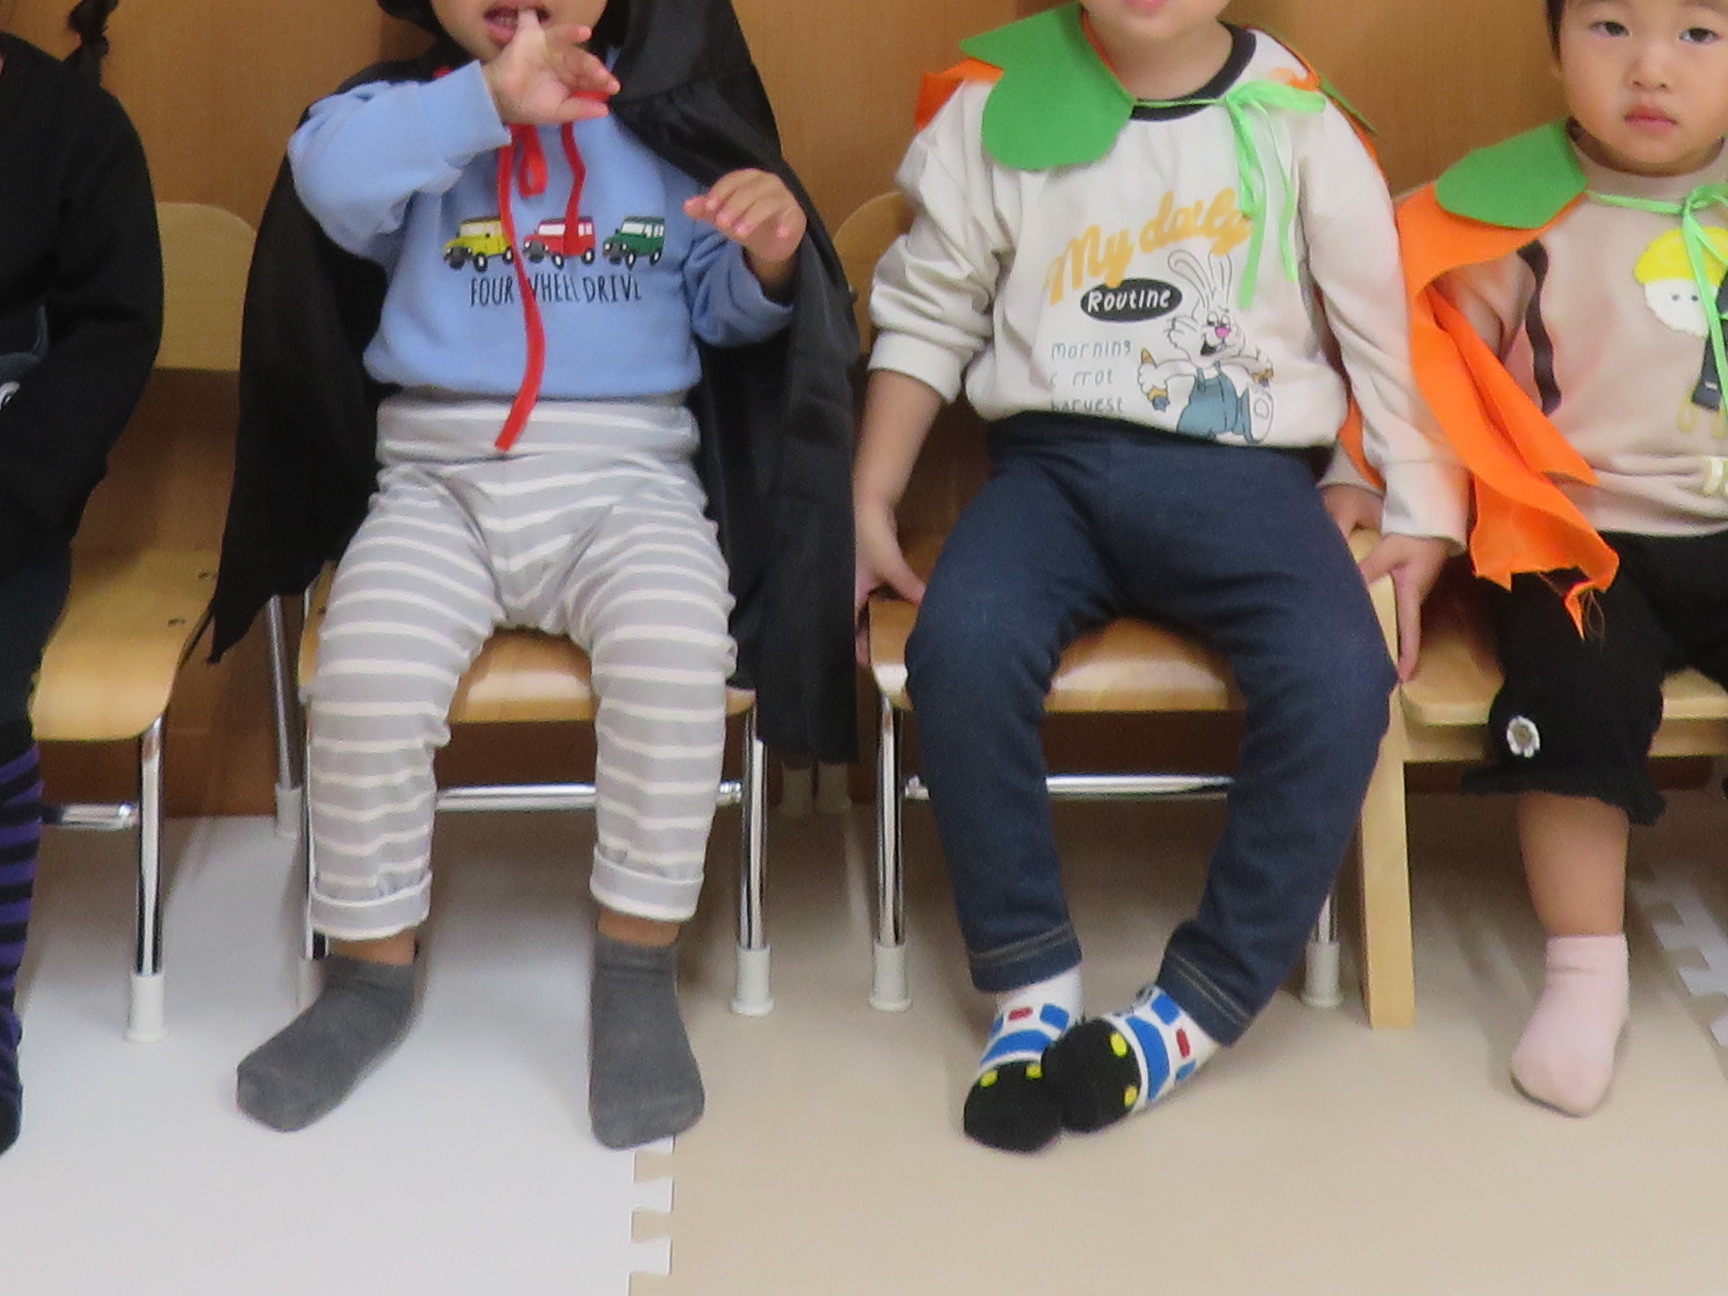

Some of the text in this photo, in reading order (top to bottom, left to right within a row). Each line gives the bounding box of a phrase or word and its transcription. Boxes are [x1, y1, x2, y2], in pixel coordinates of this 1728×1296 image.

[1043, 223, 1134, 305] My
[470, 275, 515, 307] FOUR
[1049, 368, 1113, 389] crrot
